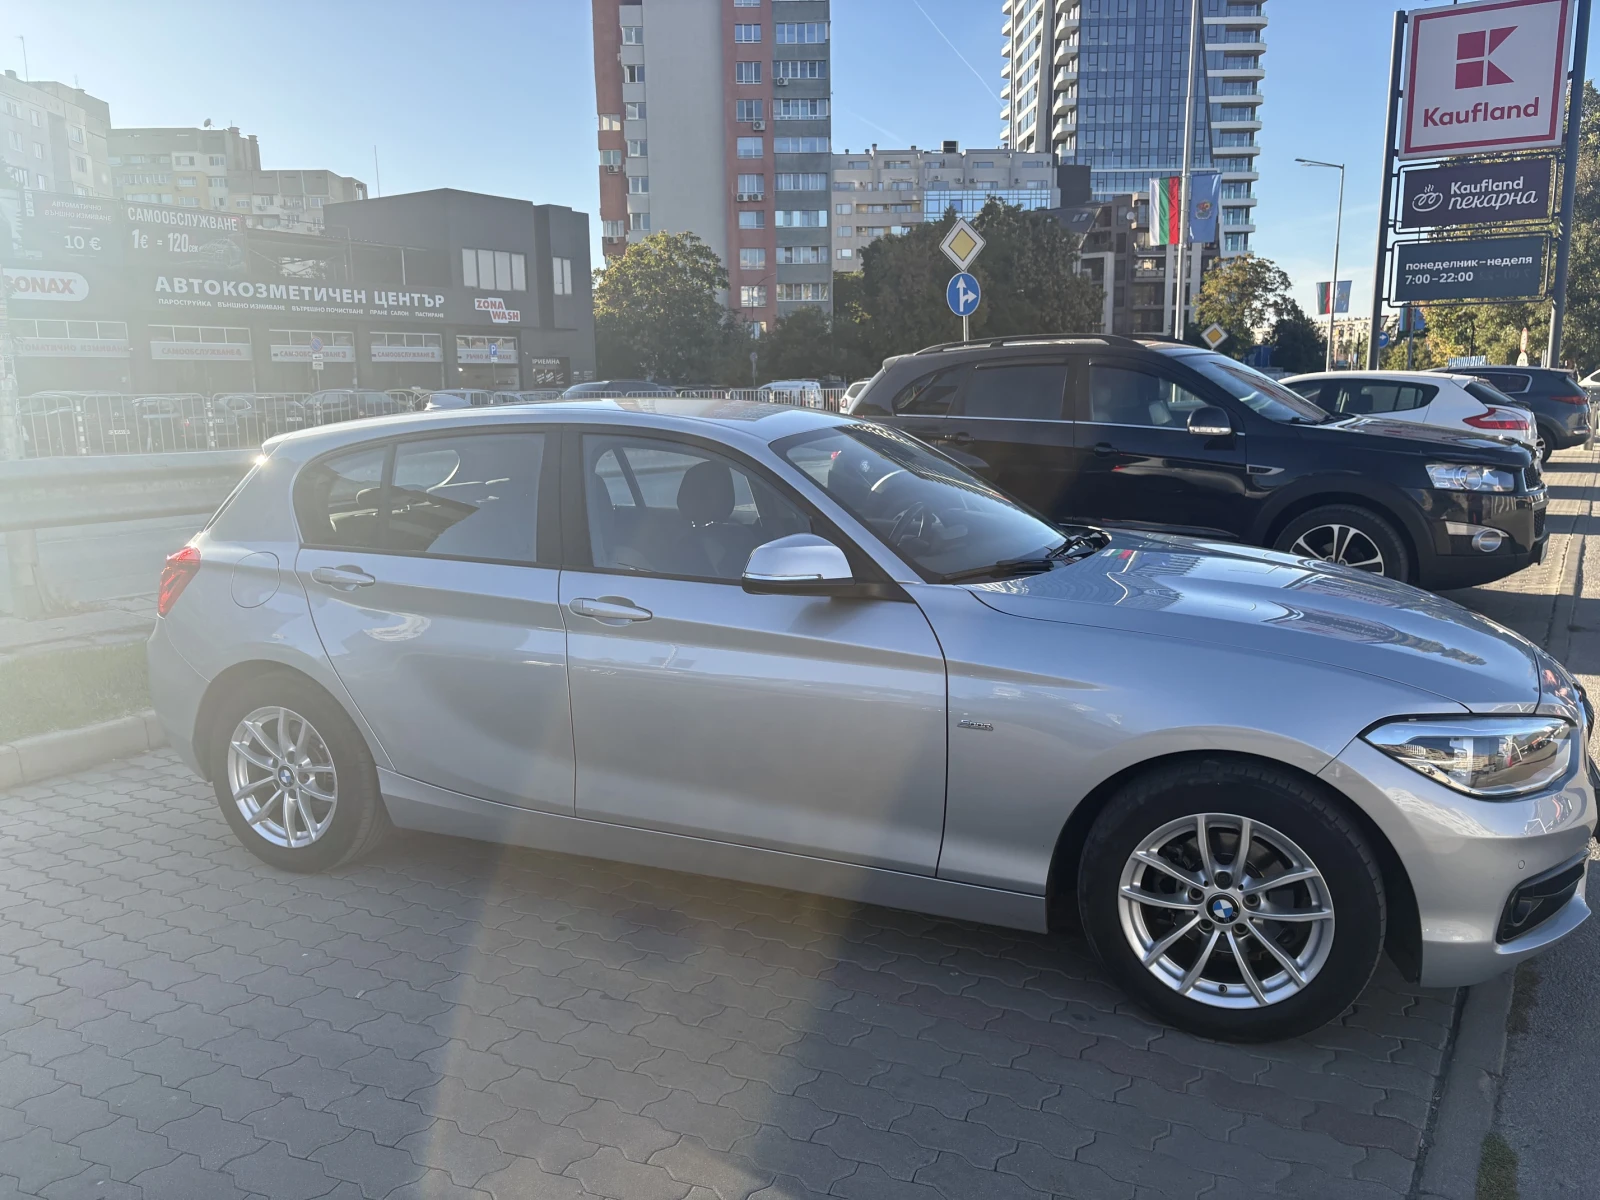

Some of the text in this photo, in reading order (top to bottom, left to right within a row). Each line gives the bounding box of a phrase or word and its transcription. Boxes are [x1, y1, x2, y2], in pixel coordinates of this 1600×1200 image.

[1423, 96, 1540, 128] Kaufland
[1450, 176, 1524, 195] Kaufland
[51, 201, 102, 211] АВТОМАТИЧНО
[1448, 190, 1539, 210] пекарна
[44, 209, 112, 222] ВЪНШНО ИЗМИВАНЕ
[128, 207, 238, 232] САМООБСЛУЖВАНЕ
[64, 235, 102, 251] 10 €
[155, 276, 445, 308] АВТОКОЗМЕТИЧЕН ЦЕНТЪР
[158, 297, 212, 307] ПАРОСТРУЙКА
[217, 301, 249, 310] ВЪНШНО
[250, 303, 286, 312] ИЗМИВАНЕ
[291, 305, 326, 313] ВЪТРЕШНО
[326, 307, 364, 315] ПОЧИСТВАНЕ
[476, 299, 504, 310] ZONA
[491, 310, 519, 321] WASH
